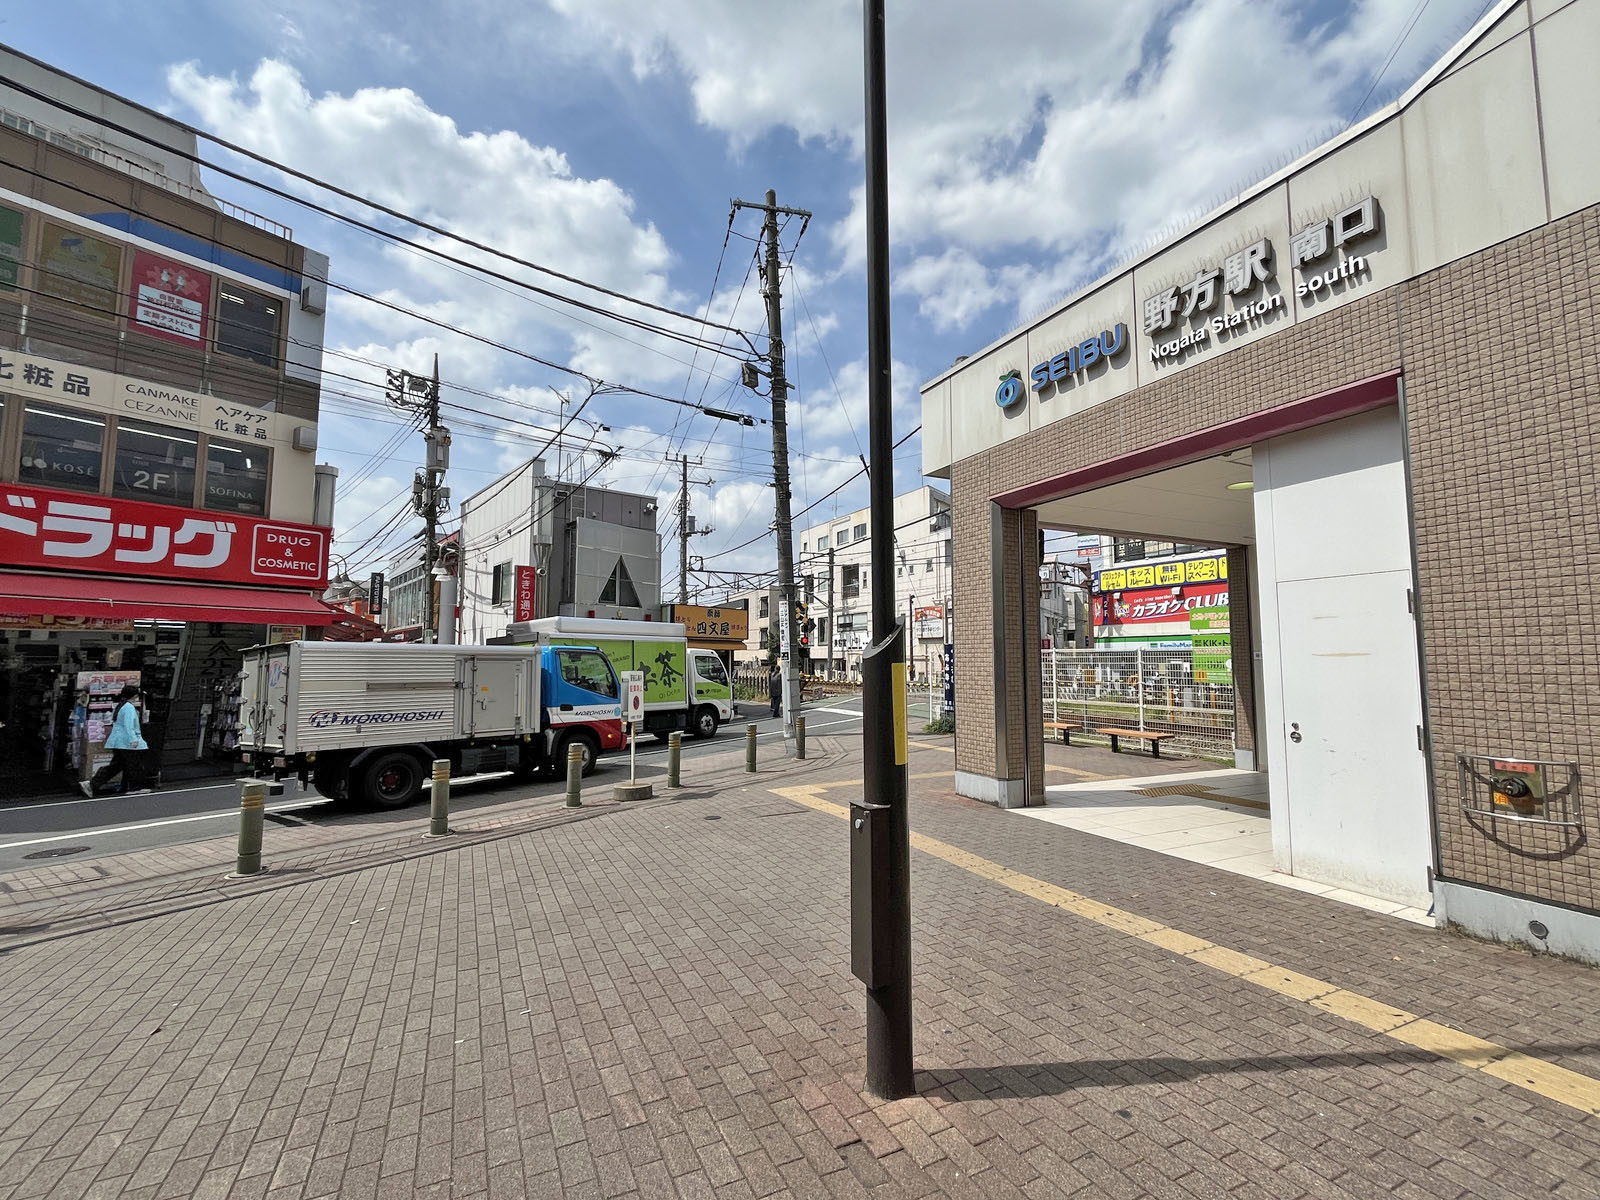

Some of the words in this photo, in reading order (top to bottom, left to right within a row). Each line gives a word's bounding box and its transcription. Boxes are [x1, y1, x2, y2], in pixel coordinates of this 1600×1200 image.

[1144, 238, 1270, 336] 野方駅
[1290, 195, 1377, 268] 南口
[1150, 328, 1205, 362] Nogata
[1211, 294, 1280, 334] Station
[1295, 255, 1364, 296] south
[1031, 322, 1125, 392] SEIBU
[125, 383, 199, 408] CANMAKE
[124, 398, 198, 422] CEZANNE
[215, 405, 267, 424] ヘアケア
[214, 418, 267, 440] 化粧品
[133, 470, 170, 490] 2F
[209, 486, 253, 500] SOFINA
[266, 533, 312, 548] DRUG
[284, 547, 294, 558] &
[257, 557, 316, 572] COSMETIC
[1130, 568, 1151, 576] キッズ
[1130, 576, 1151, 586] ルーム
[1187, 570, 1215, 580] スペース
[520, 570, 530, 620] ときわ通り
[697, 621, 730, 635] 四文屋
[340, 710, 445, 726] MOROHOSHI
